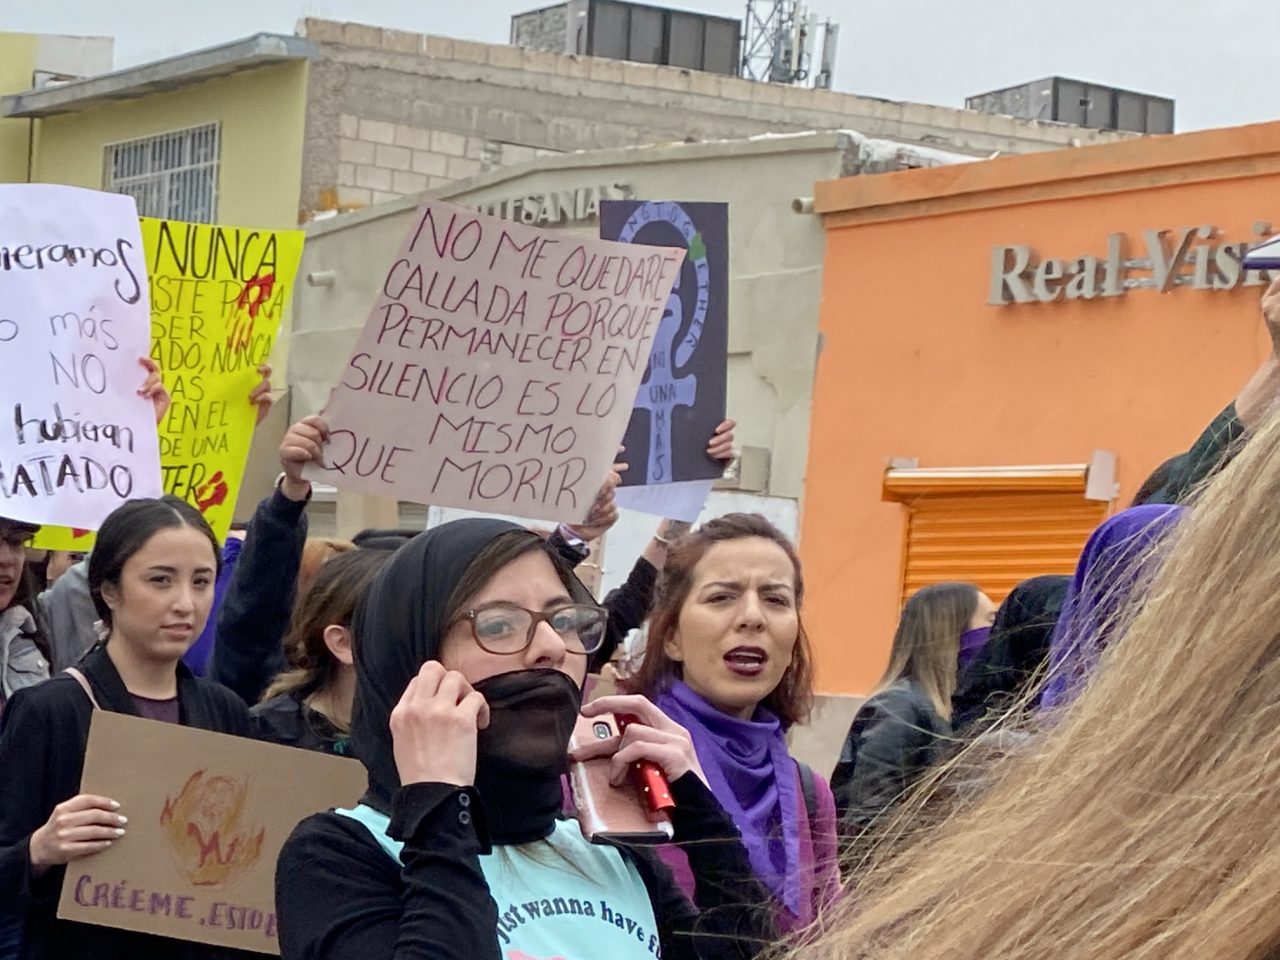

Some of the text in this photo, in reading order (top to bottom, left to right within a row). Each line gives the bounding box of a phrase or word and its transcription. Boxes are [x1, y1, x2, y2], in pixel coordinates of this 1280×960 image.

[154, 221, 277, 284] NUNCA
[409, 207, 483, 263] NO
[489, 230, 561, 280] ME
[383, 257, 660, 342] CALLADA PORQUE
[49, 305, 119, 351] más
[376, 302, 648, 377] PERMANECER EN
[49, 351, 107, 395] NO
[149, 332, 272, 374] ADO, NUNCA
[342, 352, 617, 419] SILENCIO ES LO
[649, 383, 677, 404] UNA
[14, 402, 134, 453] hubieran
[166, 400, 229, 435] EN EL
[428, 412, 578, 454] MISMO
[159, 432, 229, 459] DE UNA
[320, 429, 588, 509] QUE MORIR
[522, 896, 596, 921] wanna
[600, 900, 646, 943] have
